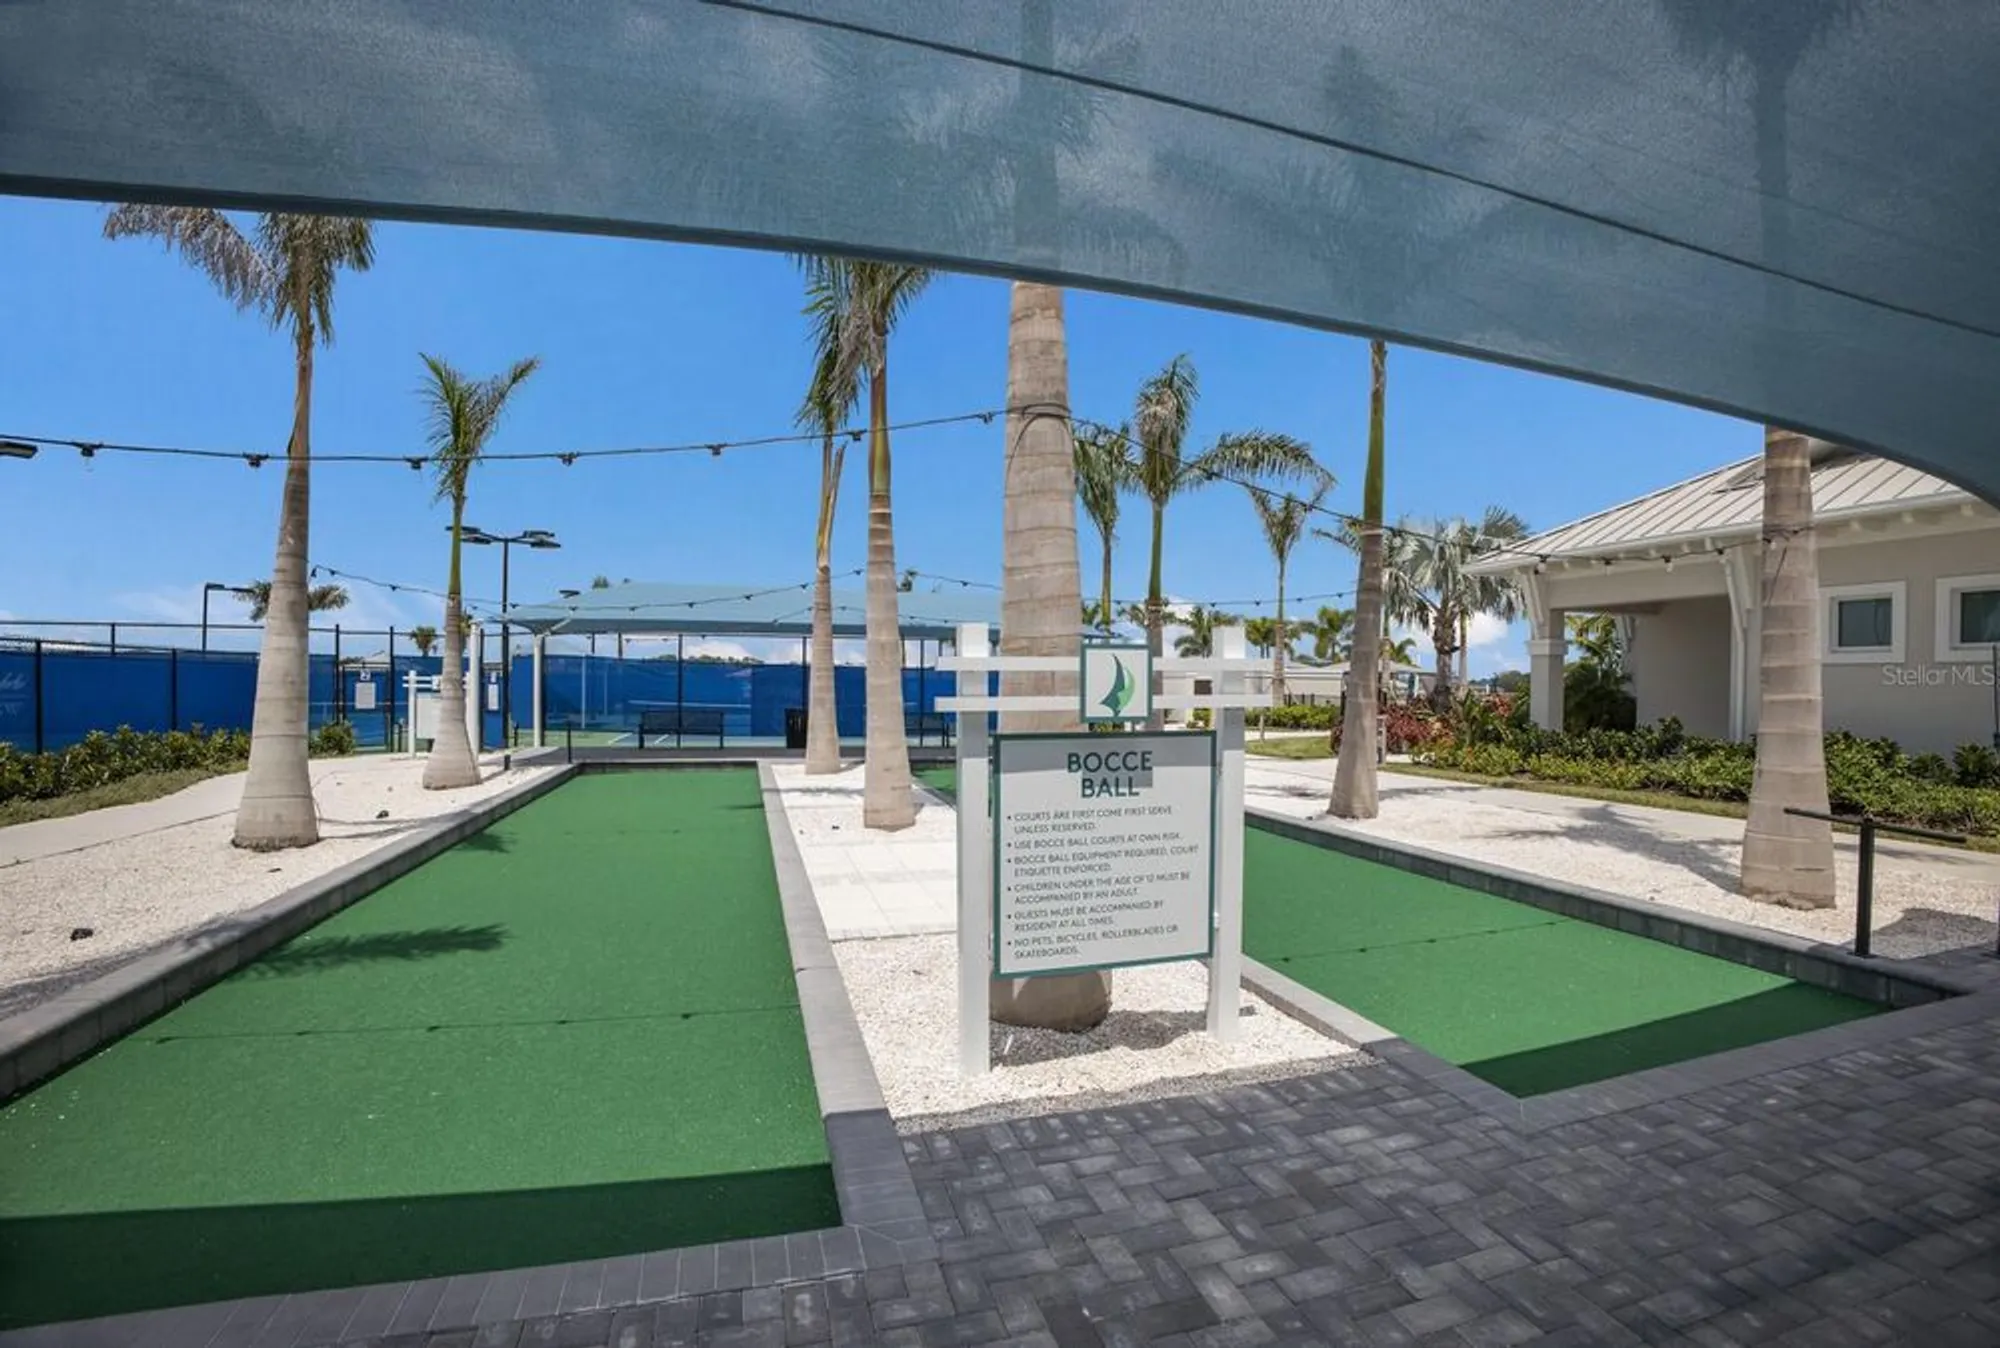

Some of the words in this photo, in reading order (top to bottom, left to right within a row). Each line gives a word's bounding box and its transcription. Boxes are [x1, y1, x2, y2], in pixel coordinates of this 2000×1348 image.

[1067, 750, 1153, 773] BOCCE
[1081, 776, 1140, 798] BALL
[1014, 811, 1051, 821] COURTS
[1053, 810, 1070, 820] ARE
[1072, 809, 1095, 819] FIRST
[1097, 808, 1122, 818] COME
[1124, 807, 1146, 817] FIRST
[1148, 805, 1172, 816] SERVE
[1014, 823, 1050, 834] UNLESS
[1051, 822, 1097, 832] RESERVED.
[1014, 840, 1032, 849] USE
[1034, 839, 1065, 849] BOCCE
[1067, 837, 1089, 847] BALL
[1091, 835, 1125, 846] COURTS
[1127, 834, 1138, 843] AT
[1139, 833, 1161, 843] OWN
[1014, 854, 1046, 865] BOCCE
[1048, 853, 1069, 863] BALL
[1072, 850, 1123, 862] EQUIPMENT
[1170, 845, 1199, 856] COURT
[1014, 866, 1061, 877] ETIQUETTE
[1014, 881, 1061, 892] CHILDREN
[1062, 879, 1093, 890] UNDER
[1096, 877, 1112, 887] THE
[1114, 875, 1131, 885] AGE
[1132, 874, 1145, 884] OF
[1156, 872, 1179, 882] MUST
[1180, 871, 1190, 881] BE
[1014, 891, 1081, 905] ACCOMPANIED
[1082, 890, 1093, 900] BY
[1096, 889, 1109, 899] AN
[1014, 909, 1049, 920] GUESTS
[1050, 907, 1074, 917] MUST
[1076, 906, 1088, 916] BE
[1089, 901, 1152, 914] ACCOMPANIED
[1153, 899, 1164, 909] BY
[1014, 920, 1058, 931] RESIDENT
[1058, 919, 1070, 929] AT
[1071, 917, 1087, 928] ALL
[1014, 938, 1030, 948] NO
[1102, 925, 1165, 940] ROLLERBLADES
[1166, 924, 1179, 934] OR
